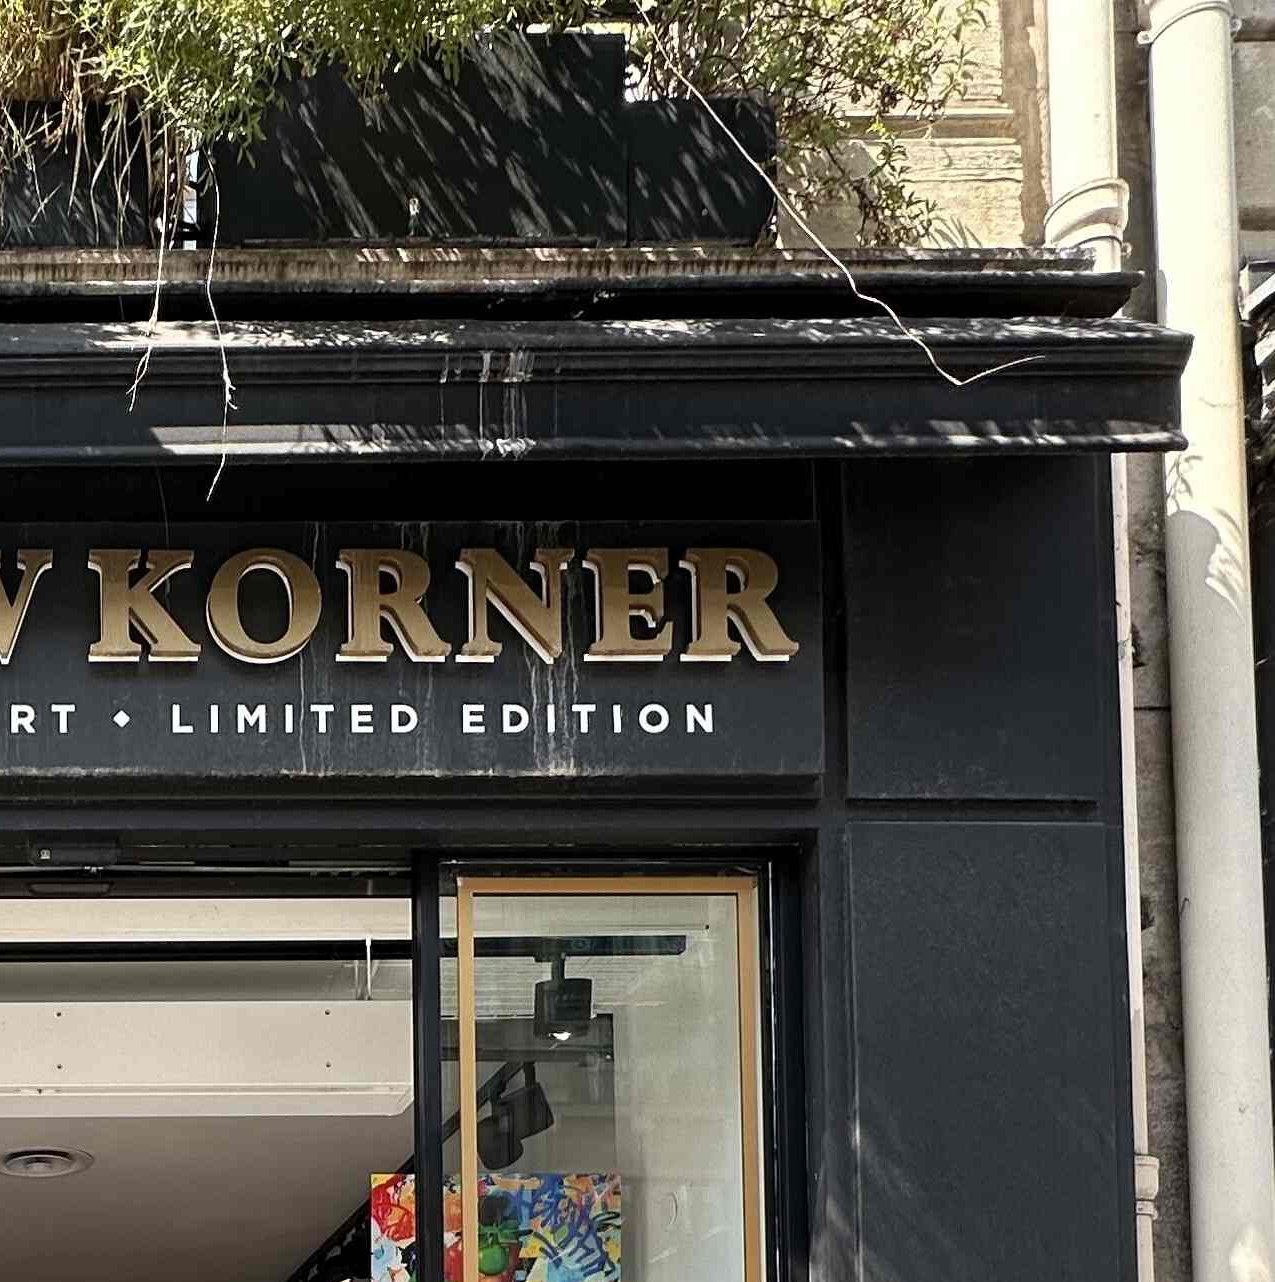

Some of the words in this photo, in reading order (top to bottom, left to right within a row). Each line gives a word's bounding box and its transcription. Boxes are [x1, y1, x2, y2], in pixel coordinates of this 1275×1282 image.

[87, 547, 800, 664] KORNER
[171, 703, 419, 733] LIMITED
[462, 703, 716, 733] EDITION
